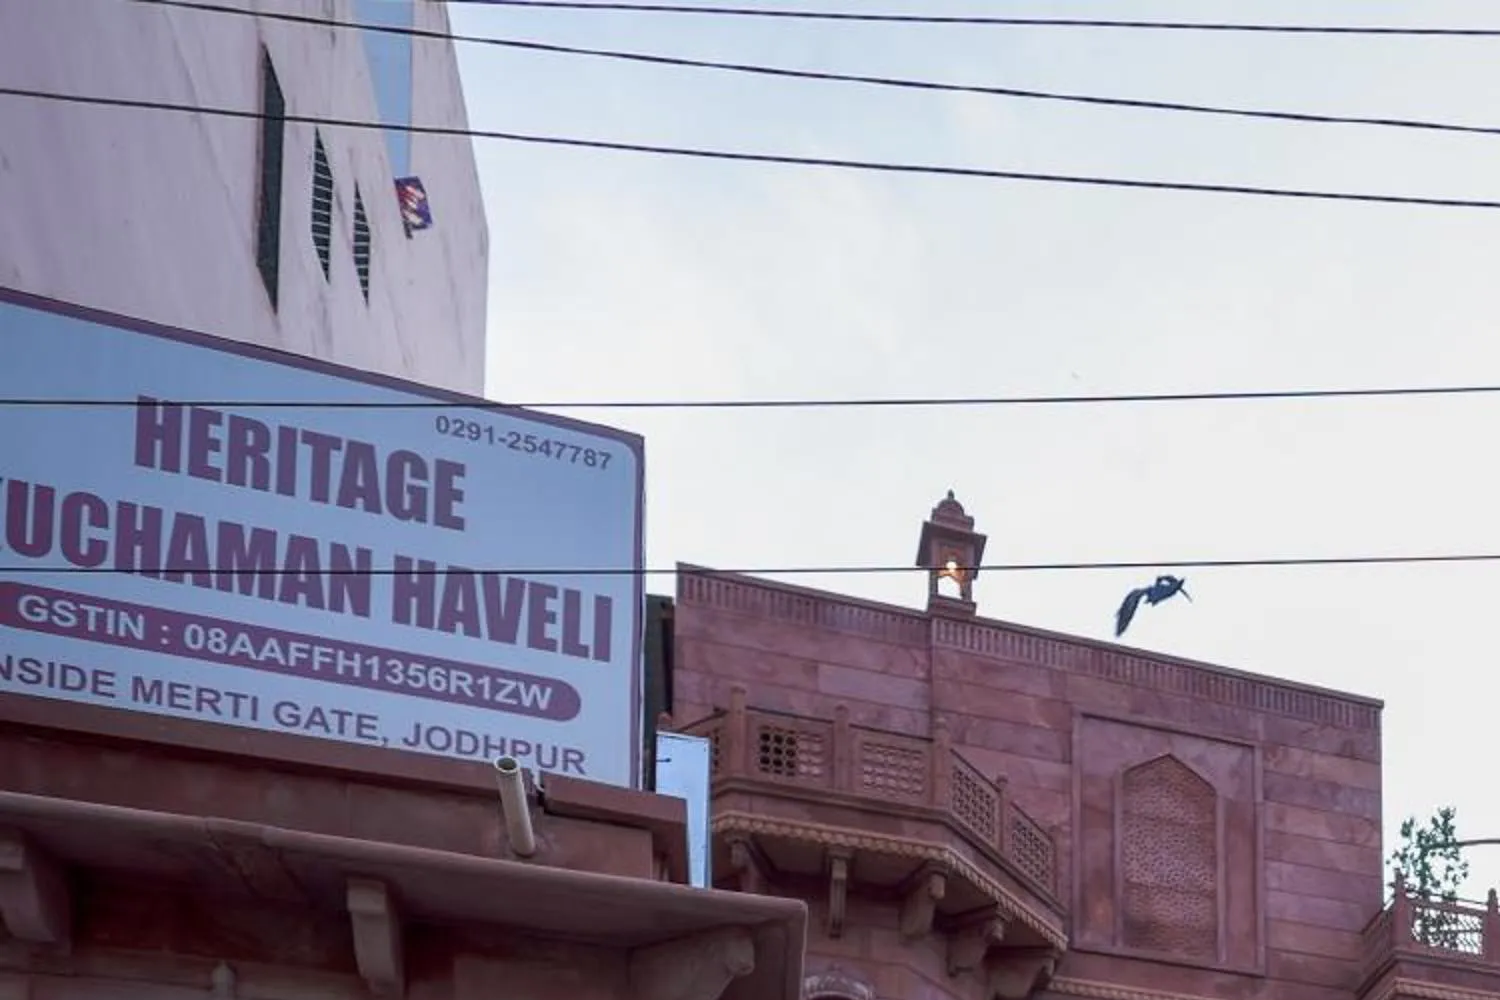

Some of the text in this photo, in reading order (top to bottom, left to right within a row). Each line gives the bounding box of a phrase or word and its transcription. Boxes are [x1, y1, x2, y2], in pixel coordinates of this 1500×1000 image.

[134, 394, 466, 531] HERITAGE
[435, 415, 612, 470] 0291-2547787
[0, 477, 612, 663] UCHAMAN HAVELI
[17, 594, 146, 641] GSTIN
[184, 623, 553, 711] 08AAFFH1356R1ZW
[131, 675, 259, 722] MERTI
[272, 700, 389, 746] GATE,
[402, 722, 586, 775] JODHPUR
